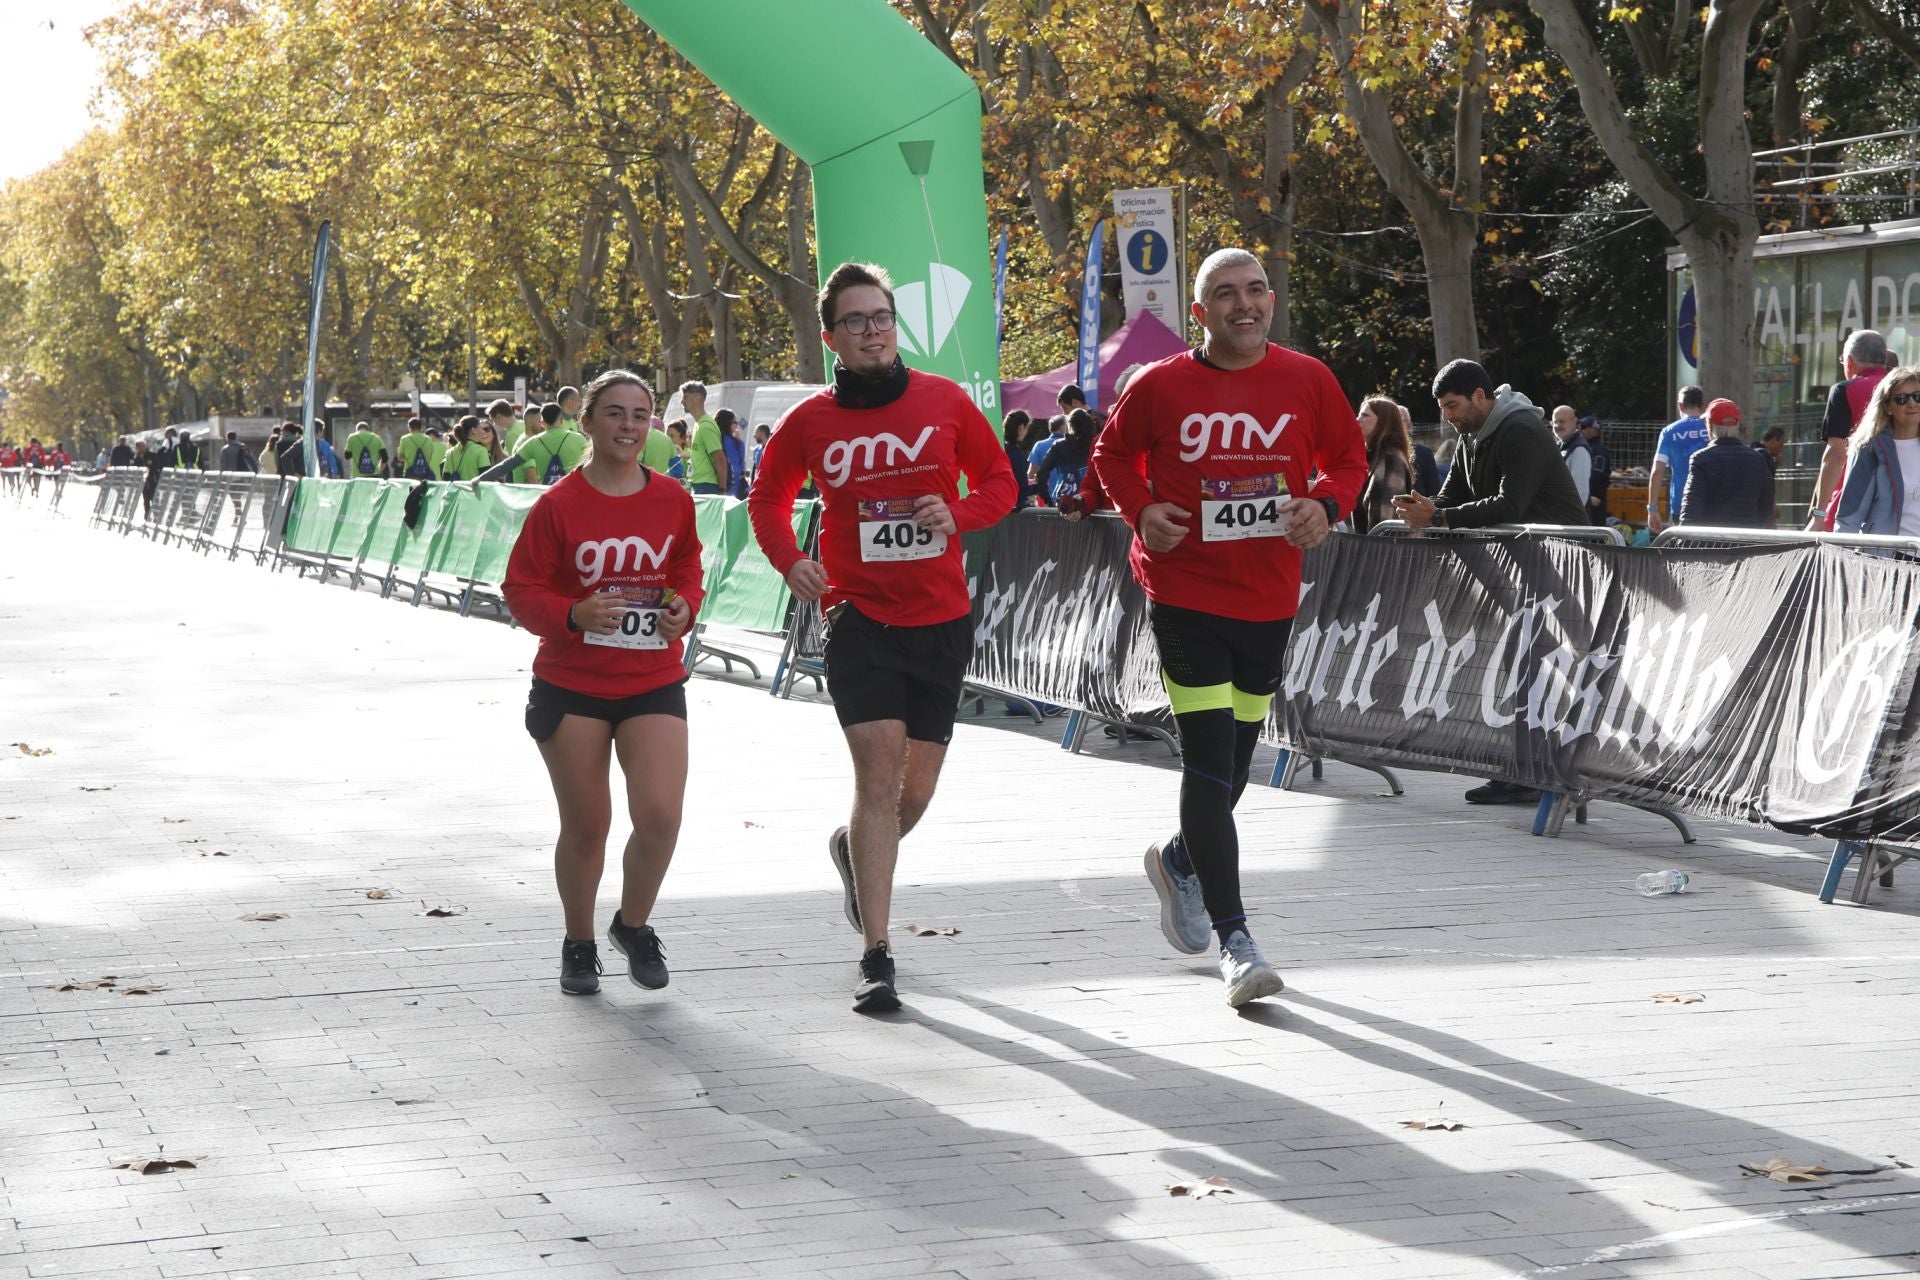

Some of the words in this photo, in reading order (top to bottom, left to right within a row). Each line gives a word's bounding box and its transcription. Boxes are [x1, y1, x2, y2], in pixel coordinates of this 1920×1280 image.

[1121, 198, 1146, 207] Oficina
[1147, 197, 1157, 206] de
[1122, 207, 1166, 217] Irmación
[1180, 412, 1292, 463] gmv
[1672, 429, 1709, 441] IVEC
[823, 426, 935, 489] gmv
[1210, 453, 1254, 462] INNOVATING
[1255, 454, 1291, 462] SOLUTIONS
[855, 470, 899, 483] INNOVATING
[900, 464, 939, 476] SOLUTIONS
[1214, 499, 1280, 528] 404
[872, 523, 933, 549] 405
[575, 534, 673, 587] gmv
[600, 575, 642, 583] INNOVATING
[620, 610, 658, 637] 03
[1282, 582, 1399, 715] orte
[1400, 600, 1477, 723] de
